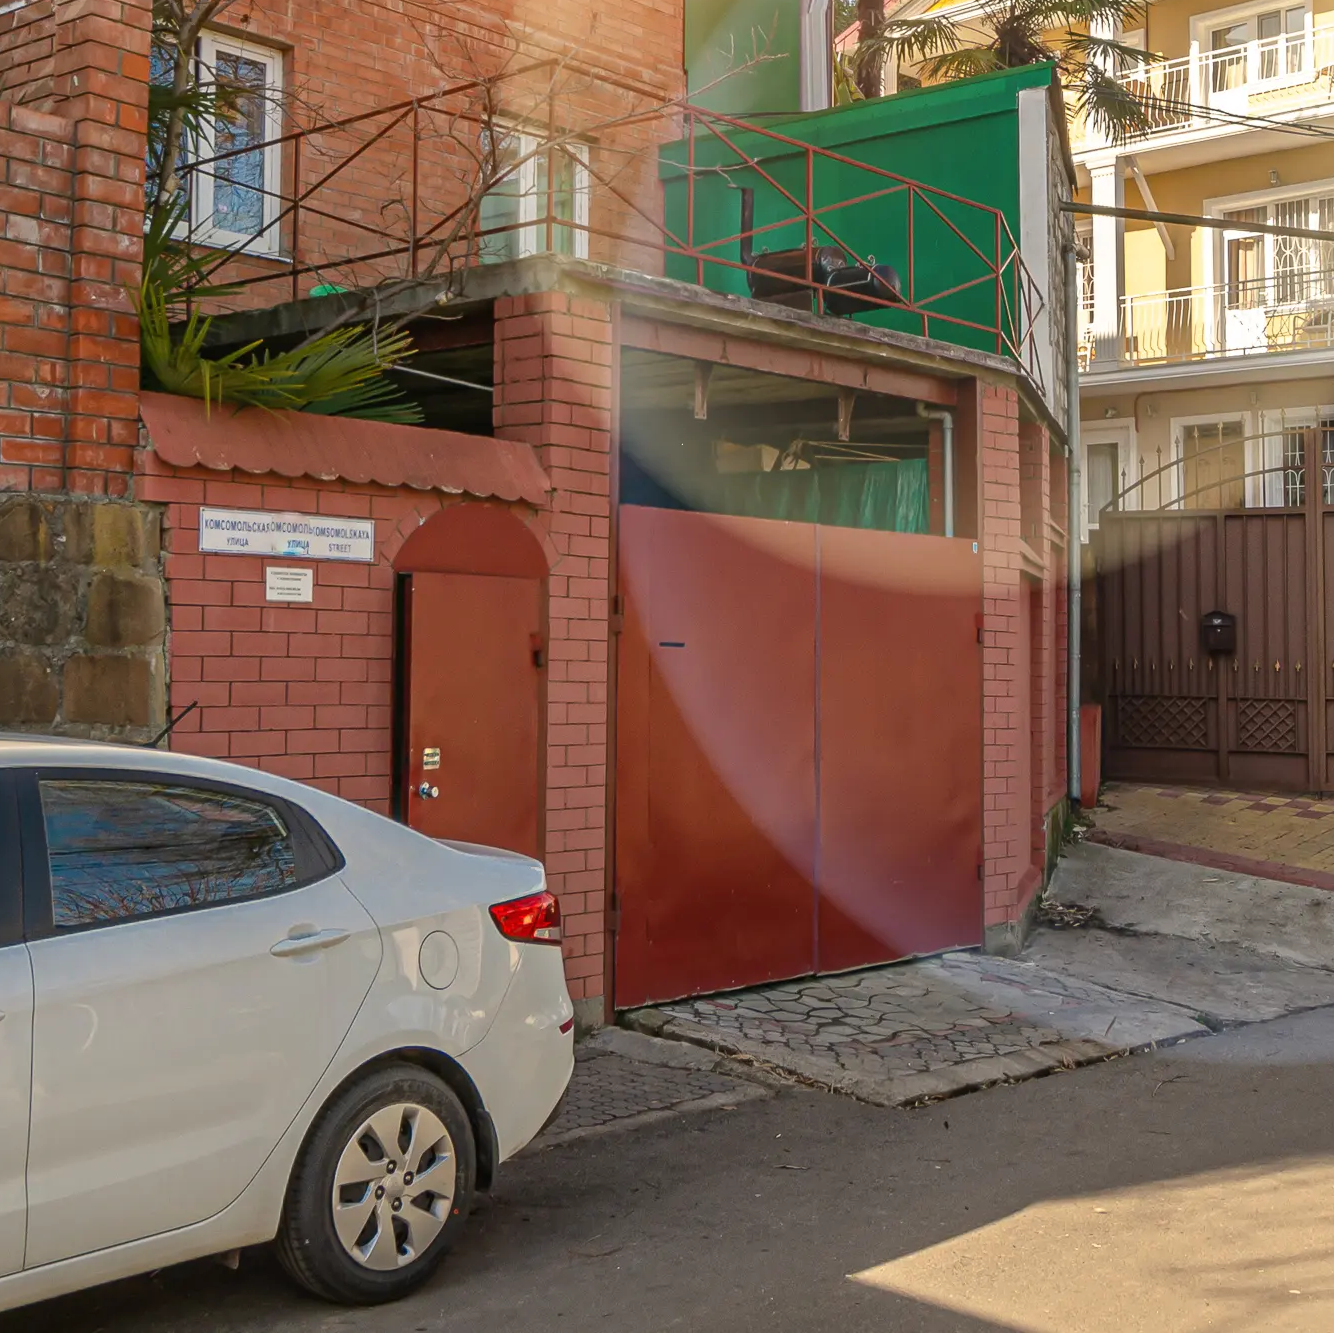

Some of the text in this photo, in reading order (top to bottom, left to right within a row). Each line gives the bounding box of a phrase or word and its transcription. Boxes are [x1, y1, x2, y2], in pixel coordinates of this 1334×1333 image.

[226, 537, 249, 547] УЛИЦА
[288, 539, 310, 550] УЛИЦА
[328, 543, 351, 553] STREET
